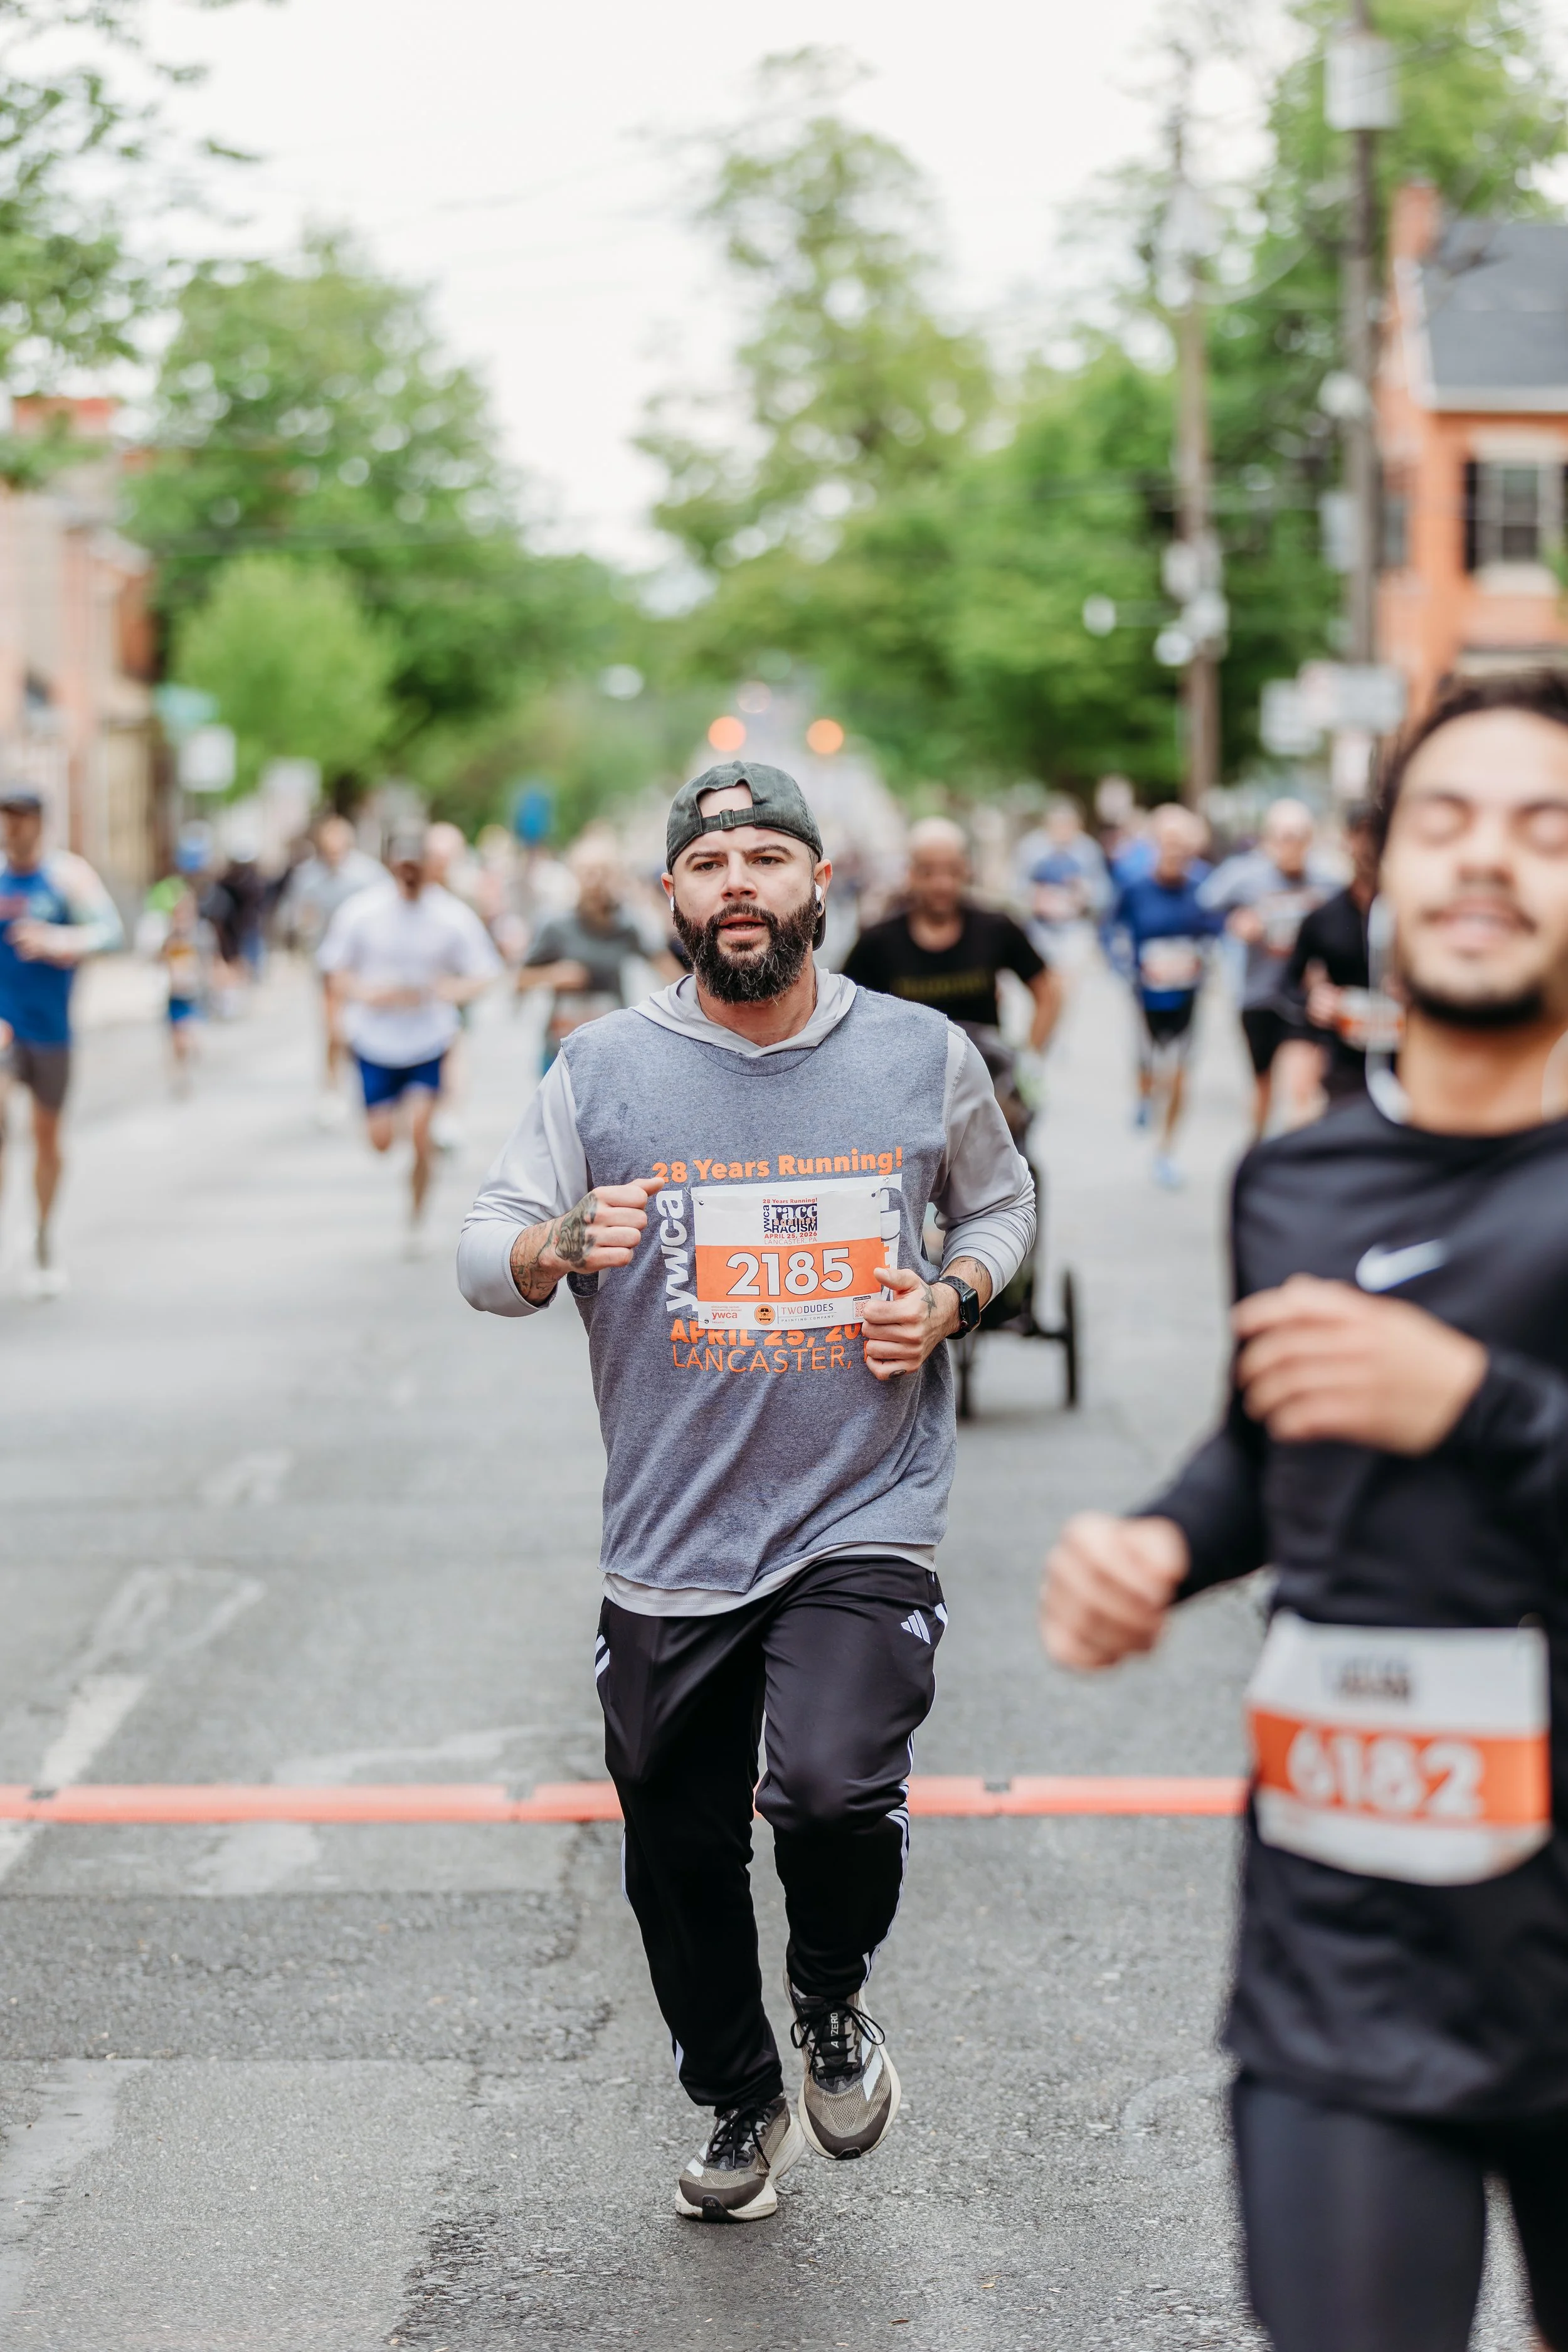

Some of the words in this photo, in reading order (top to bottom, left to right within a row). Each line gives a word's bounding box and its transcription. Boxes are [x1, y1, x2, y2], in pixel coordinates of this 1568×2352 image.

[652, 1162, 688, 1184] 28
[693, 1158, 770, 1180] Years
[778, 1146, 903, 1175] Running!
[763, 1205, 771, 1232] ywca
[771, 1205, 818, 1219] race
[773, 1217, 816, 1227] against
[772, 1224, 817, 1233] RACISM
[656, 1190, 697, 1311] ywca
[726, 1248, 854, 1296] 2185
[670, 1319, 756, 1346] APRIL
[825, 1323, 864, 1343] 20
[672, 1344, 852, 1373] LANCASTER,
[1286, 1725, 1483, 1820] 6182
[830, 2013, 839, 2048] AZERO
